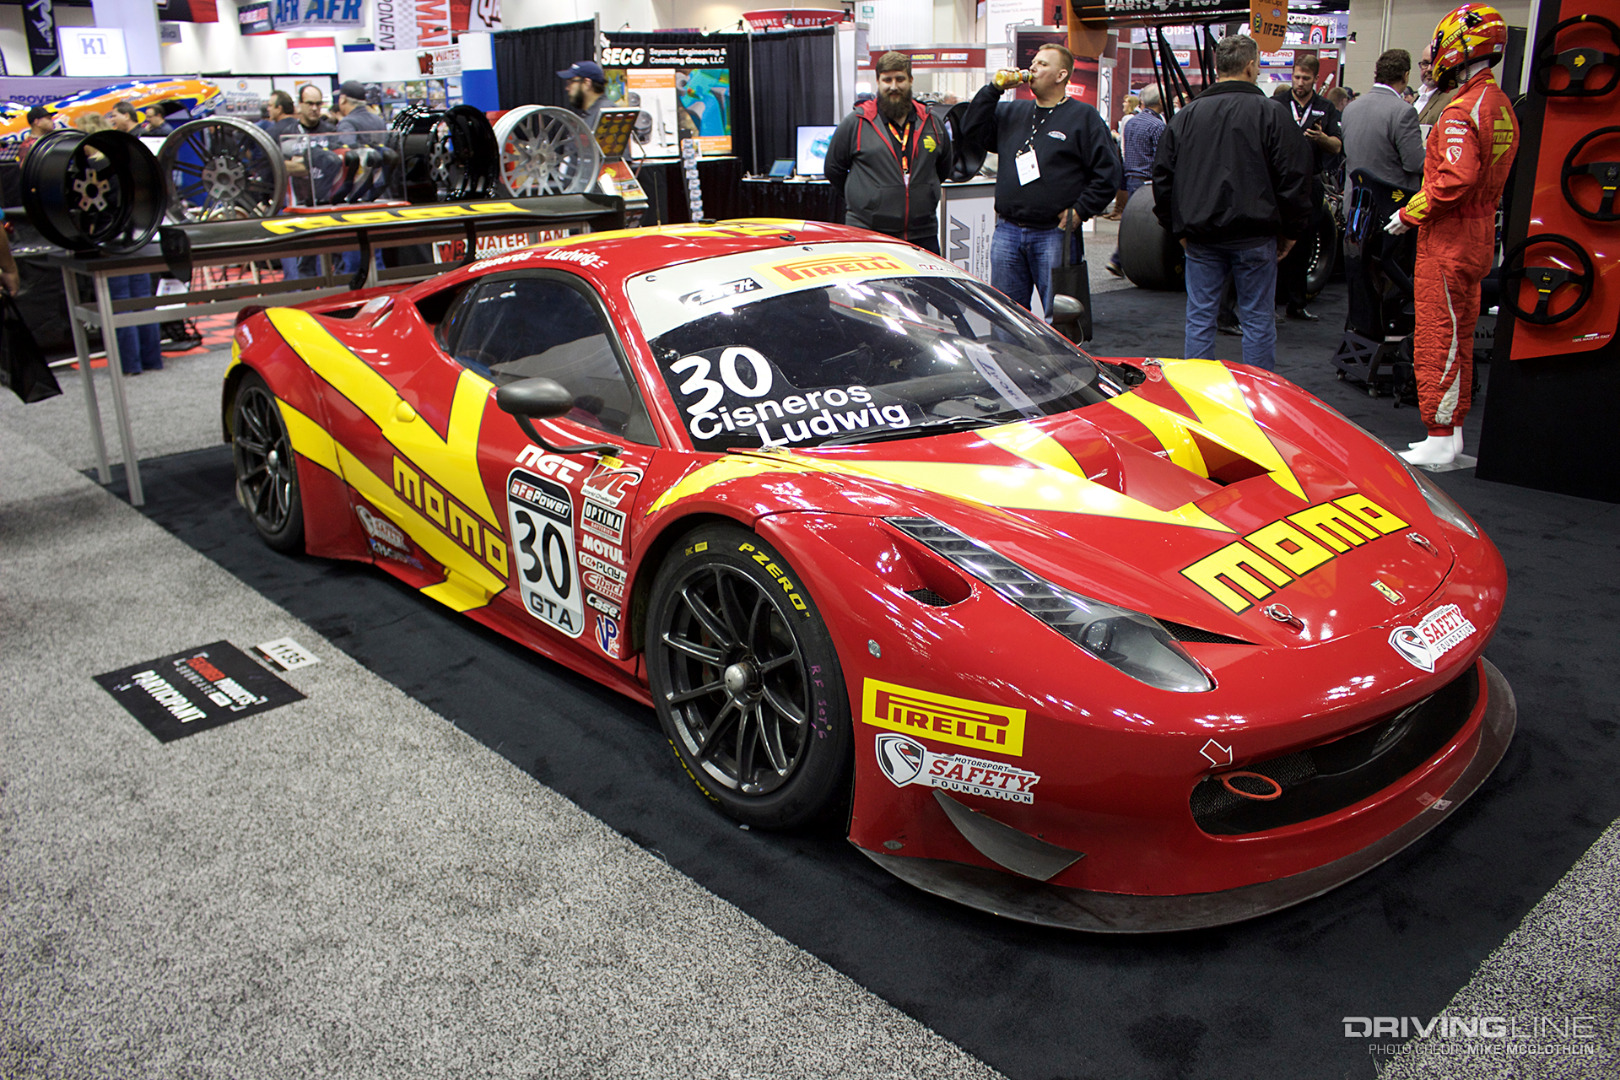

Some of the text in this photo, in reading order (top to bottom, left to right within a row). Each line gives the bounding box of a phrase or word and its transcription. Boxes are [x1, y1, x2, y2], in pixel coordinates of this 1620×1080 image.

[304, 0, 361, 19] AFR
[81, 38, 106, 55] K1
[601, 47, 646, 66] SECG
[649, 47, 678, 57] Seymour
[678, 48, 720, 57] Engineering
[649, 57, 685, 66] Consulting
[685, 57, 709, 66] Group,
[475, 229, 564, 250] WATERAN
[468, 248, 601, 272] Cisneros Ludwig
[772, 256, 901, 281] PIRELLI
[670, 346, 773, 416] 30
[690, 385, 873, 440] Cisneros
[755, 402, 911, 447] Ludwig
[595, 493, 617, 506] Challenge
[585, 502, 622, 531] OPTIMA
[515, 510, 571, 600] 30
[582, 534, 625, 565] MOTUL
[584, 572, 624, 598] Eibach
[530, 591, 574, 631] GTA
[596, 614, 619, 652] VP
[1422, 607, 1466, 645] SAFETY
[1436, 623, 1475, 653] FOUNDATION
[270, 643, 307, 665] 1135
[131, 669, 207, 724] PARTICIPANT
[875, 689, 1010, 746] PIRELLI
[929, 759, 1037, 793] SAFETY
[954, 756, 1009, 772] MOTORSPORT
[931, 778, 1032, 803] FOUNDATION
